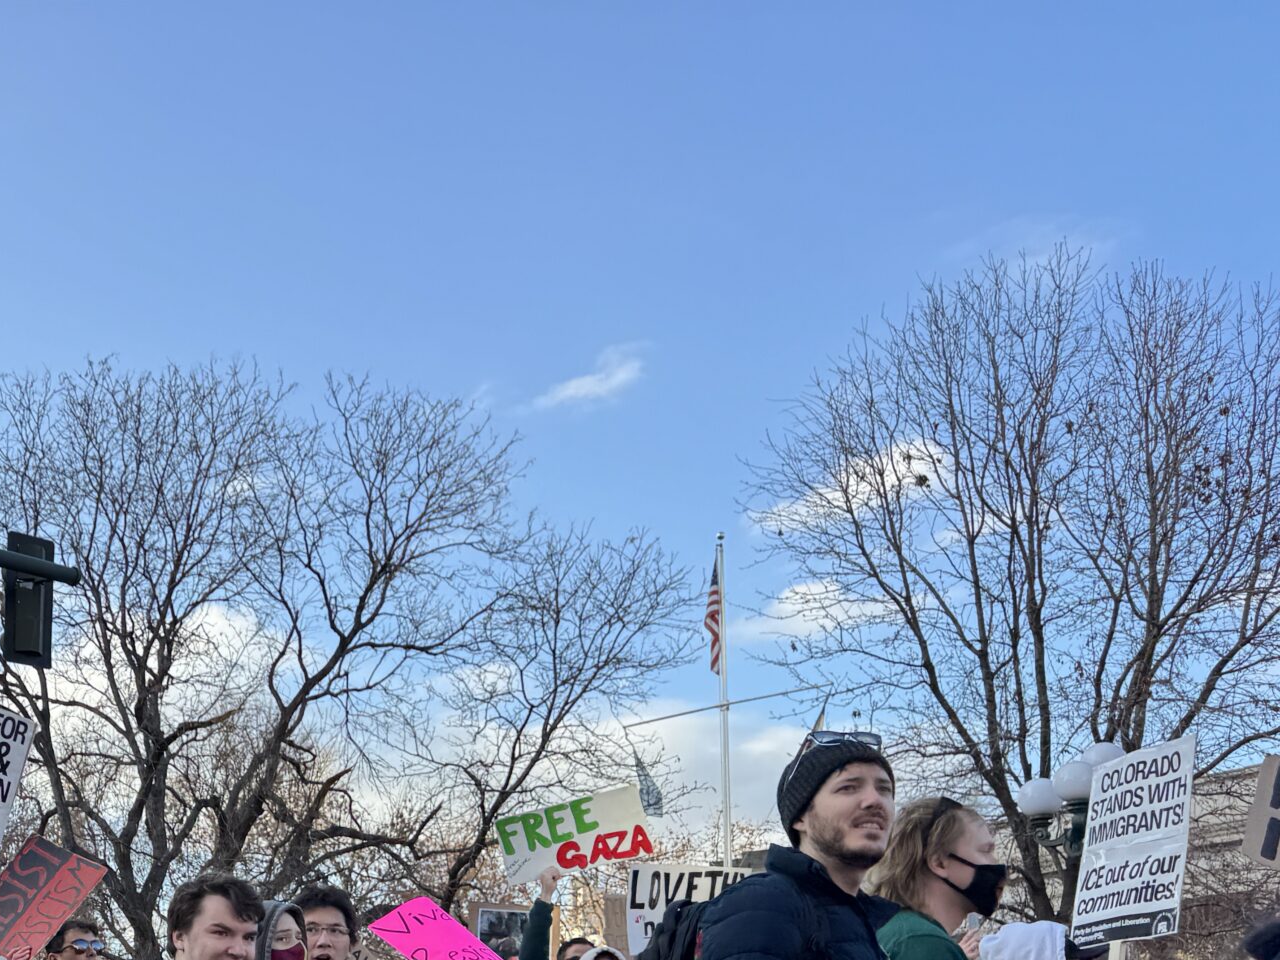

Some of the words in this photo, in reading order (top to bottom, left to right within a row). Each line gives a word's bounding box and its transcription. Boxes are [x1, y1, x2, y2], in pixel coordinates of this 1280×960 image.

[1101, 751, 1181, 793] COLORADO
[1090, 786, 1145, 821] STANDS
[1148, 774, 1188, 805] WITH
[495, 796, 599, 856] FREE
[1088, 802, 1185, 847] IMMIGRANTS!
[556, 824, 654, 870] GAZA
[630, 870, 702, 910] LOVE
[704, 870, 747, 901] TH
[1080, 865, 1106, 892] ICE
[1105, 860, 1130, 886] out
[1129, 855, 1152, 880] of
[1149, 854, 1182, 876] our
[1077, 874, 1180, 916] communities!
[371, 908, 453, 935] Viva
[1122, 917, 1151, 927] Liberation
